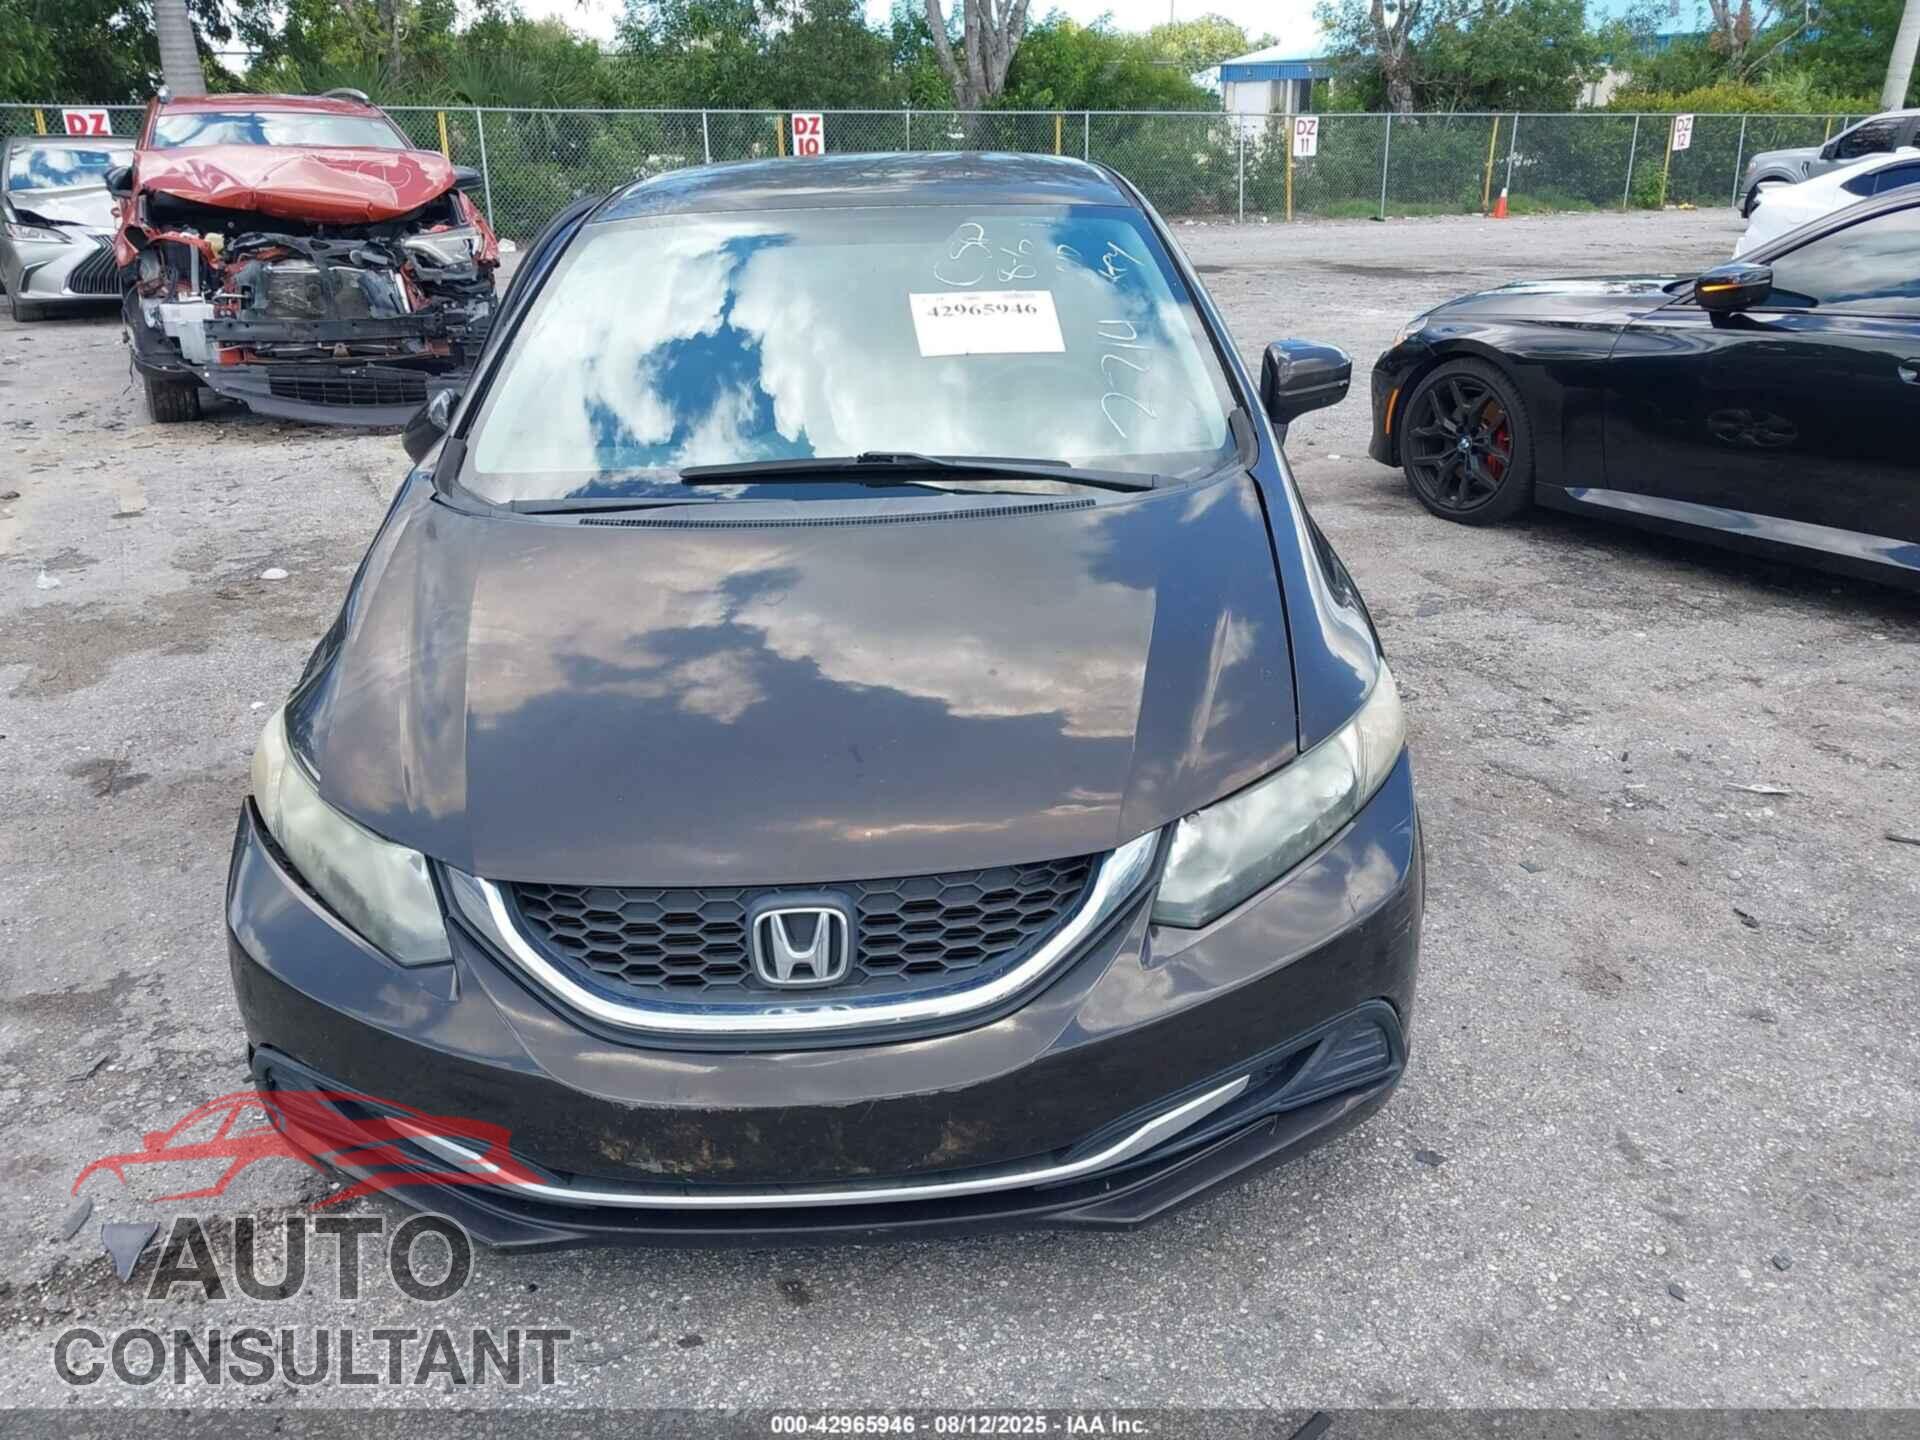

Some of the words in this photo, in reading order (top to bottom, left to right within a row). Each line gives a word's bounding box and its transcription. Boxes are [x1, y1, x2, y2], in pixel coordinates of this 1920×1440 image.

[66, 113, 108, 134] DZ
[794, 116, 820, 135] DZ
[1296, 119, 1316, 135] DZ
[1676, 117, 1691, 132] DZ
[798, 137, 819, 157] 10
[1301, 138, 1309, 152] 11
[927, 302, 1038, 318] 42965946
